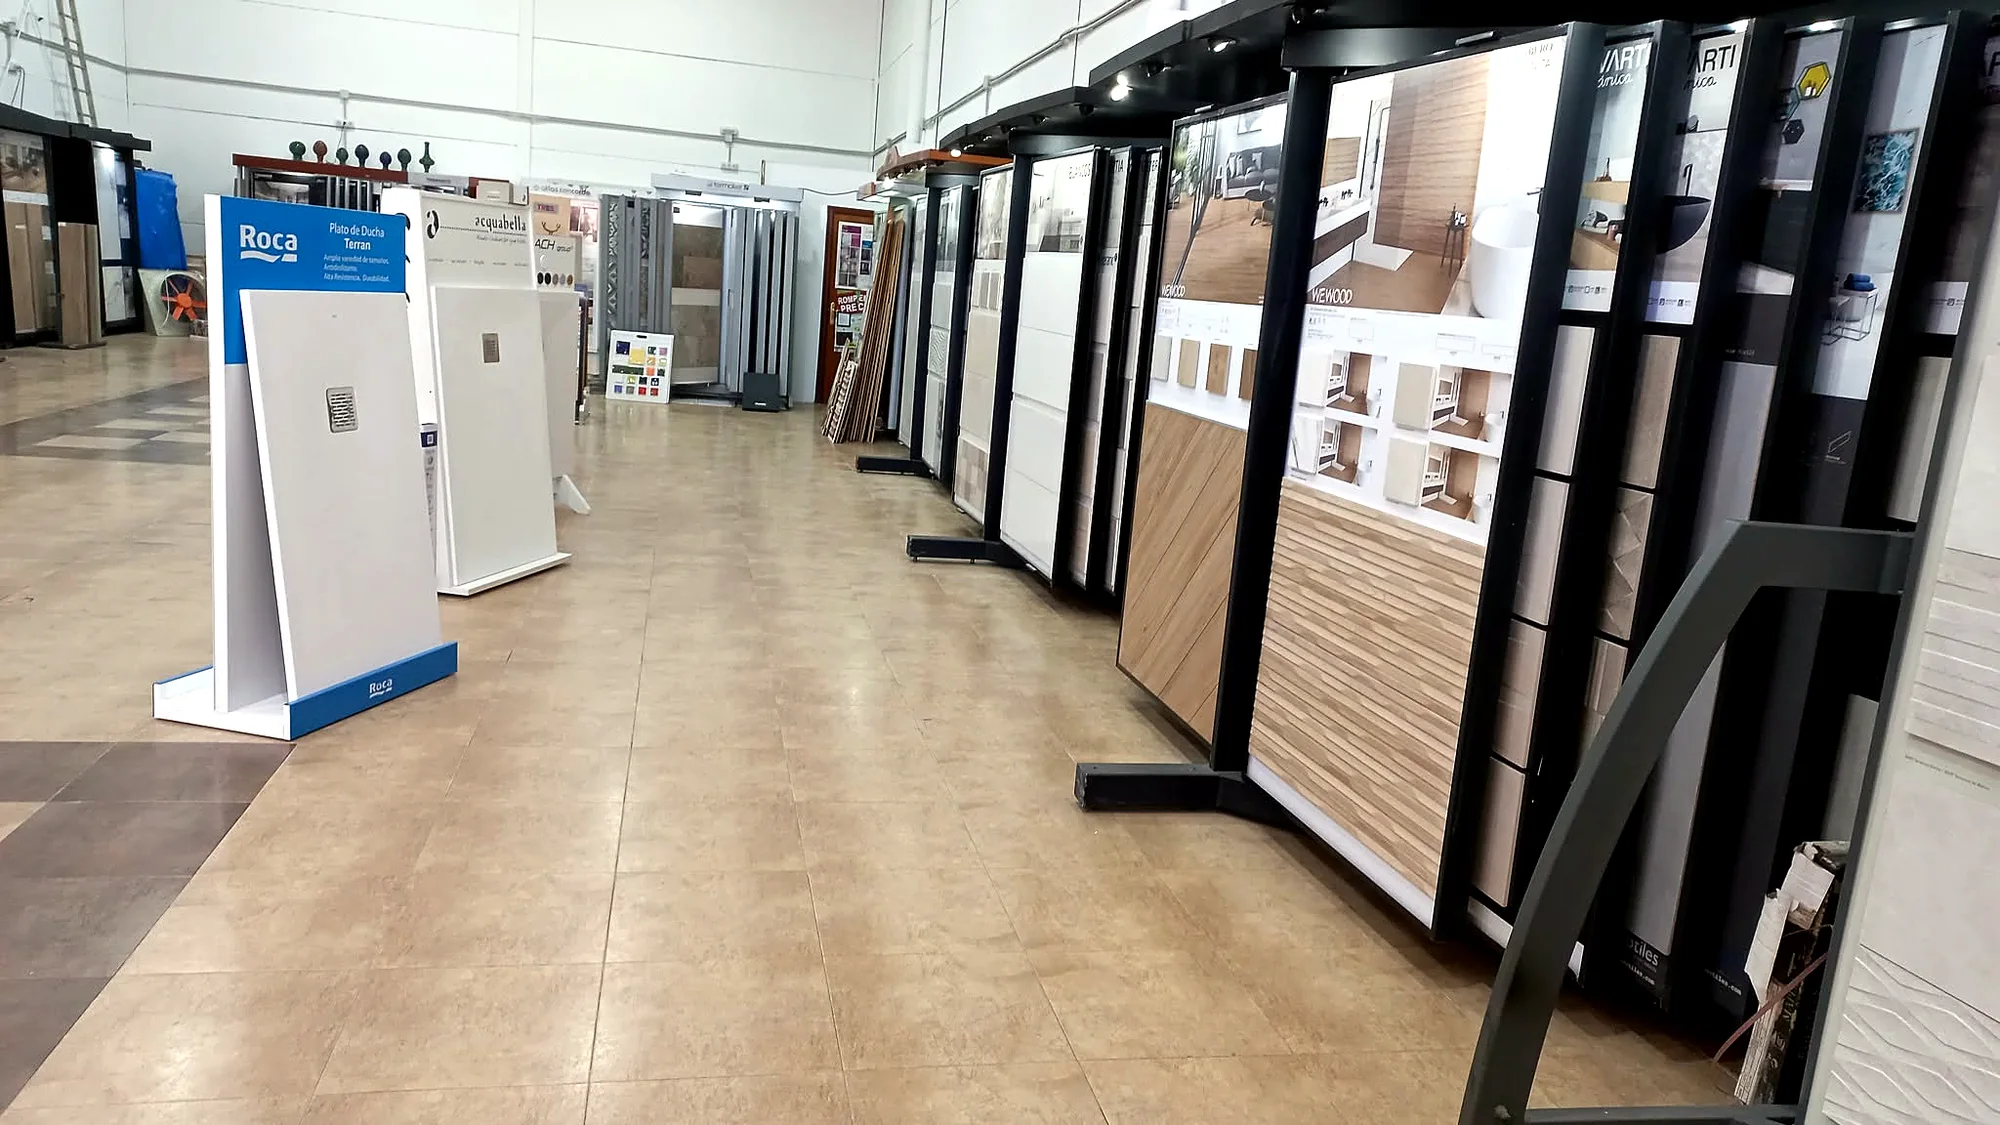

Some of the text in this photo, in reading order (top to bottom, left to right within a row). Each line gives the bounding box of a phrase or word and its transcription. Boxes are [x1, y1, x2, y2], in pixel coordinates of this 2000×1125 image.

[329, 222, 385, 238] Plato de Ducha
[474, 213, 527, 231] acquabella
[239, 224, 298, 251] Roca
[344, 237, 371, 251] Terran
[535, 238, 556, 250] ACH
[1161, 284, 1186, 298] WEWOOD
[1311, 287, 1354, 304] WEWOOD
[369, 678, 393, 695] Roca
